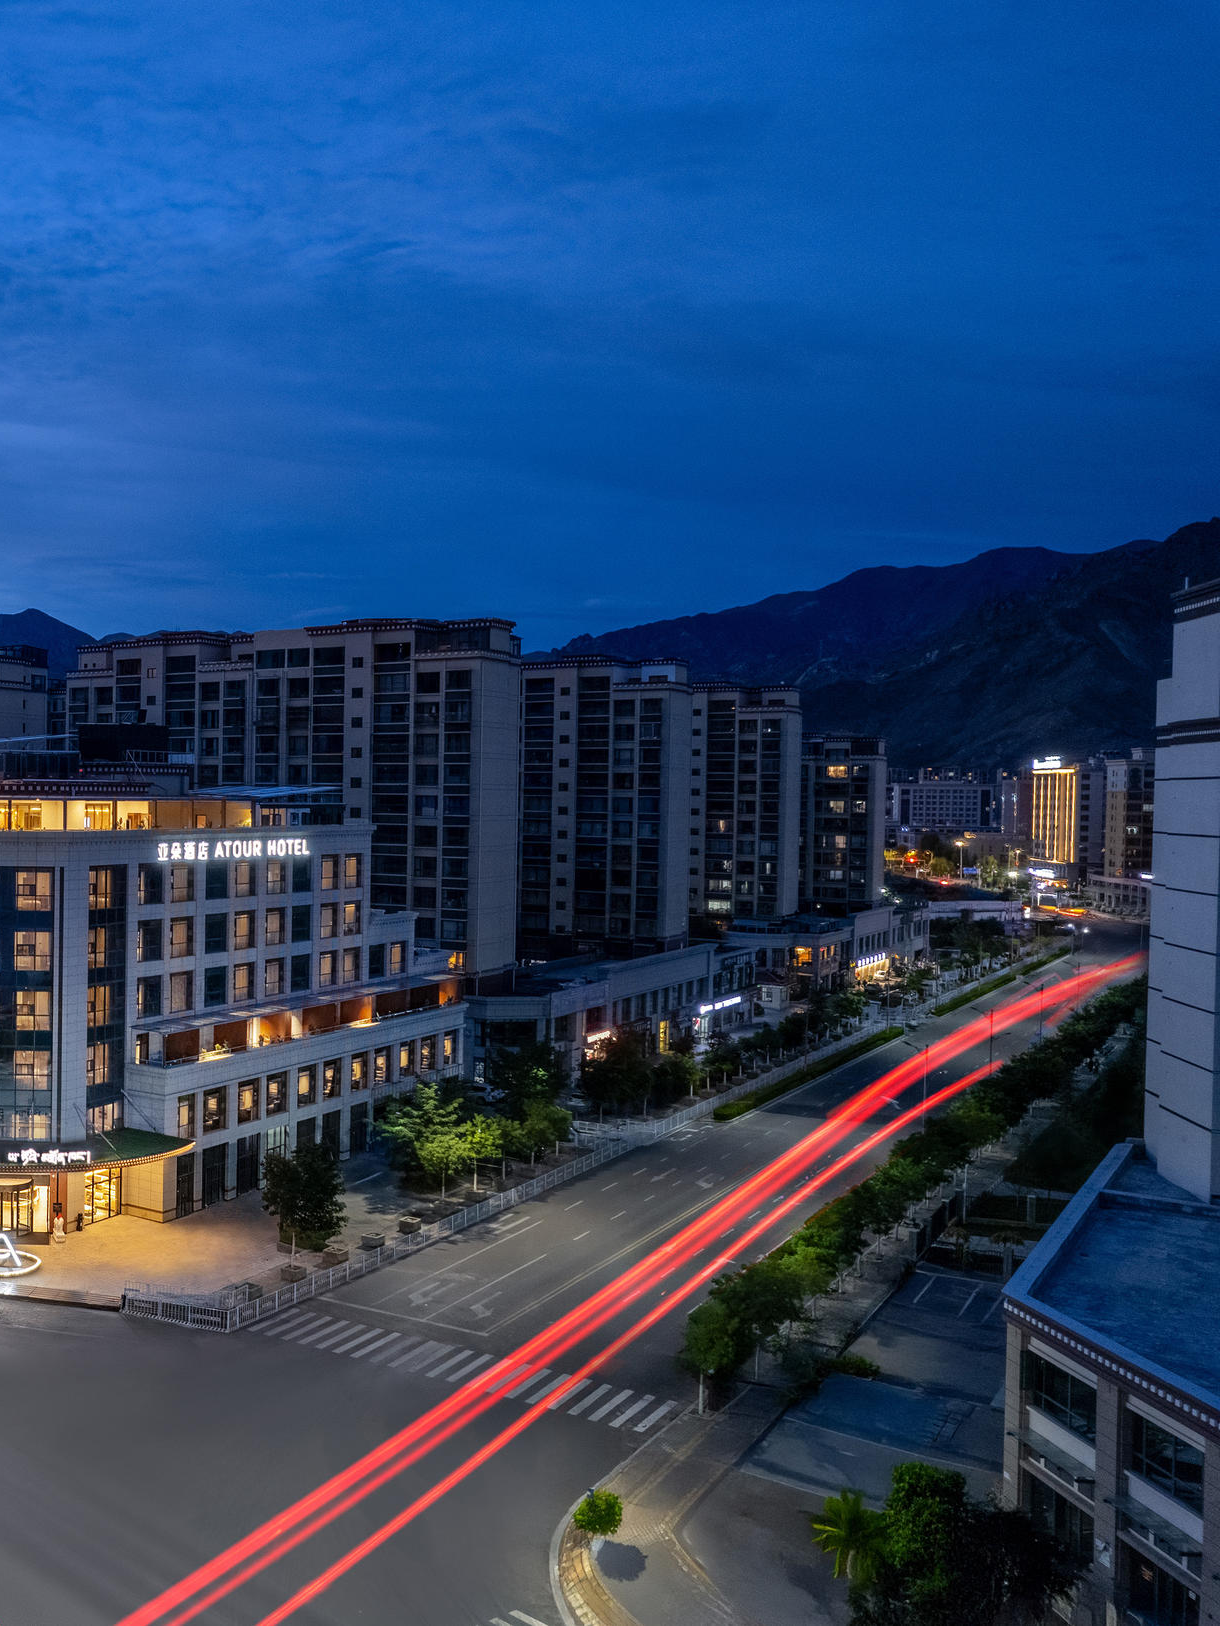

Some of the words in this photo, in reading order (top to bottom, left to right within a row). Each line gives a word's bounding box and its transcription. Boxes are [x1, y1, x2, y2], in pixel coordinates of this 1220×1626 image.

[157, 840, 209, 861] 亚朵酒店
[214, 840, 262, 859] ATOUR
[267, 839, 310, 857] HOTEL
